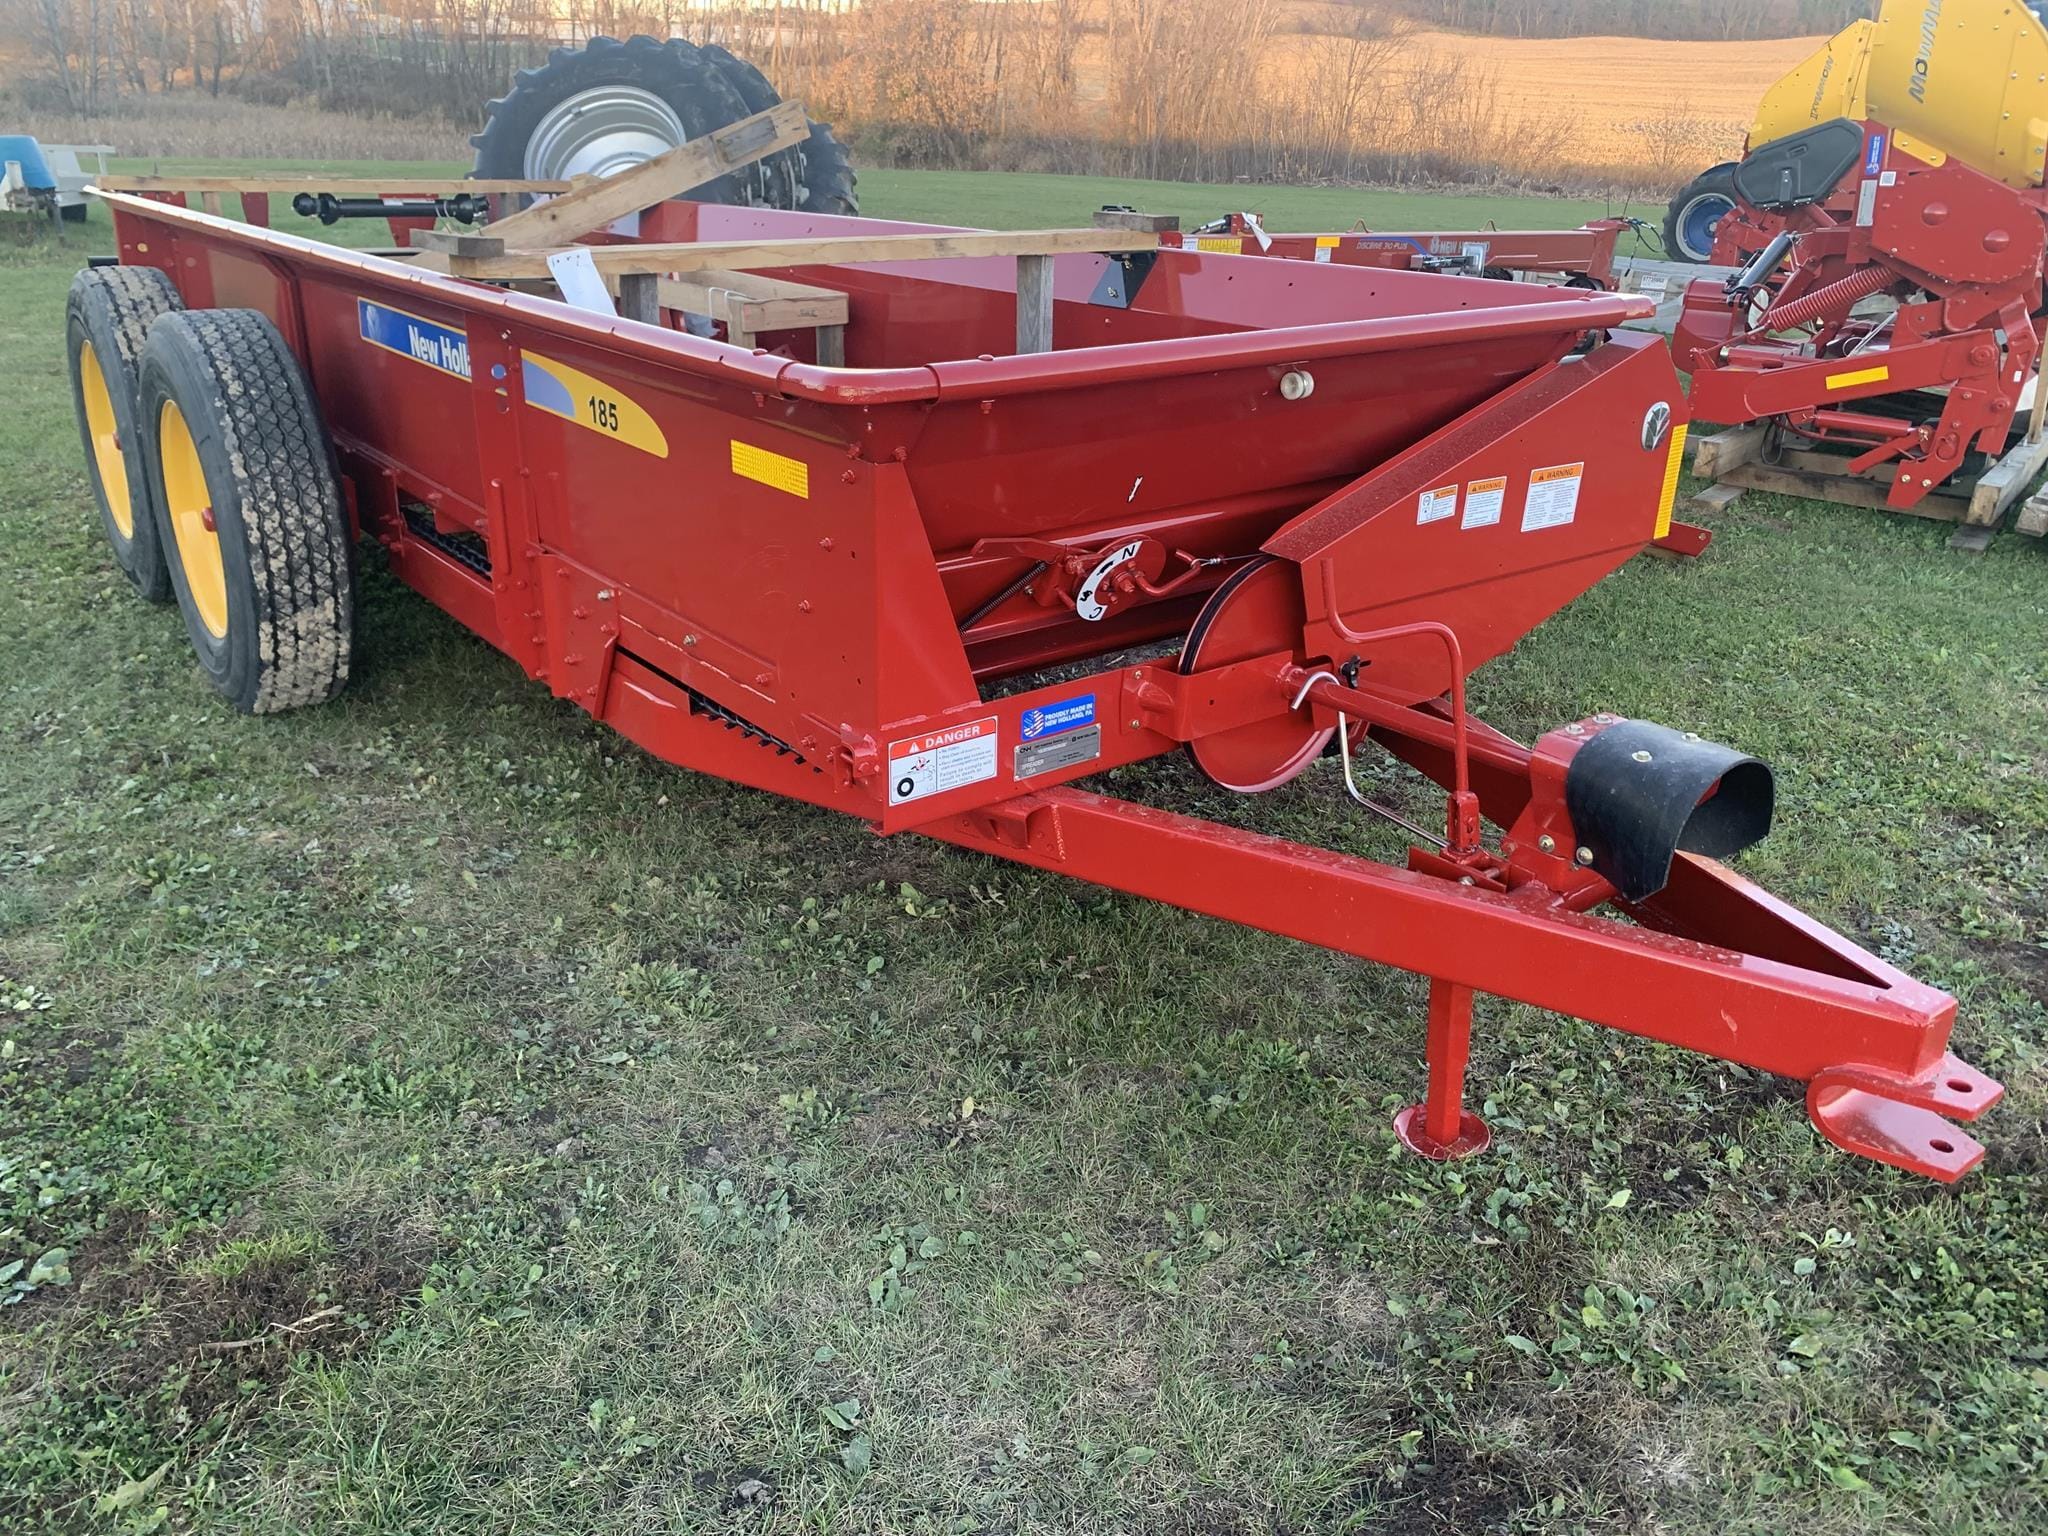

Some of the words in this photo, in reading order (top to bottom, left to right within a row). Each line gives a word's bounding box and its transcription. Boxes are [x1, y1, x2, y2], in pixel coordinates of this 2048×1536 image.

[1440, 241, 1458, 254] NEW
[408, 324, 438, 365] New
[439, 335, 471, 377] Holl
[589, 395, 618, 431] 185
[1547, 468, 1574, 479] WARNING
[1122, 545, 1135, 560] N
[1044, 708, 1070, 721] PROUDLY
[1069, 704, 1086, 713] MADE
[1086, 702, 1093, 710] IN
[1044, 718, 1058, 728] NEW
[1085, 709, 1093, 717] PA
[925, 726, 981, 749] DANGER
